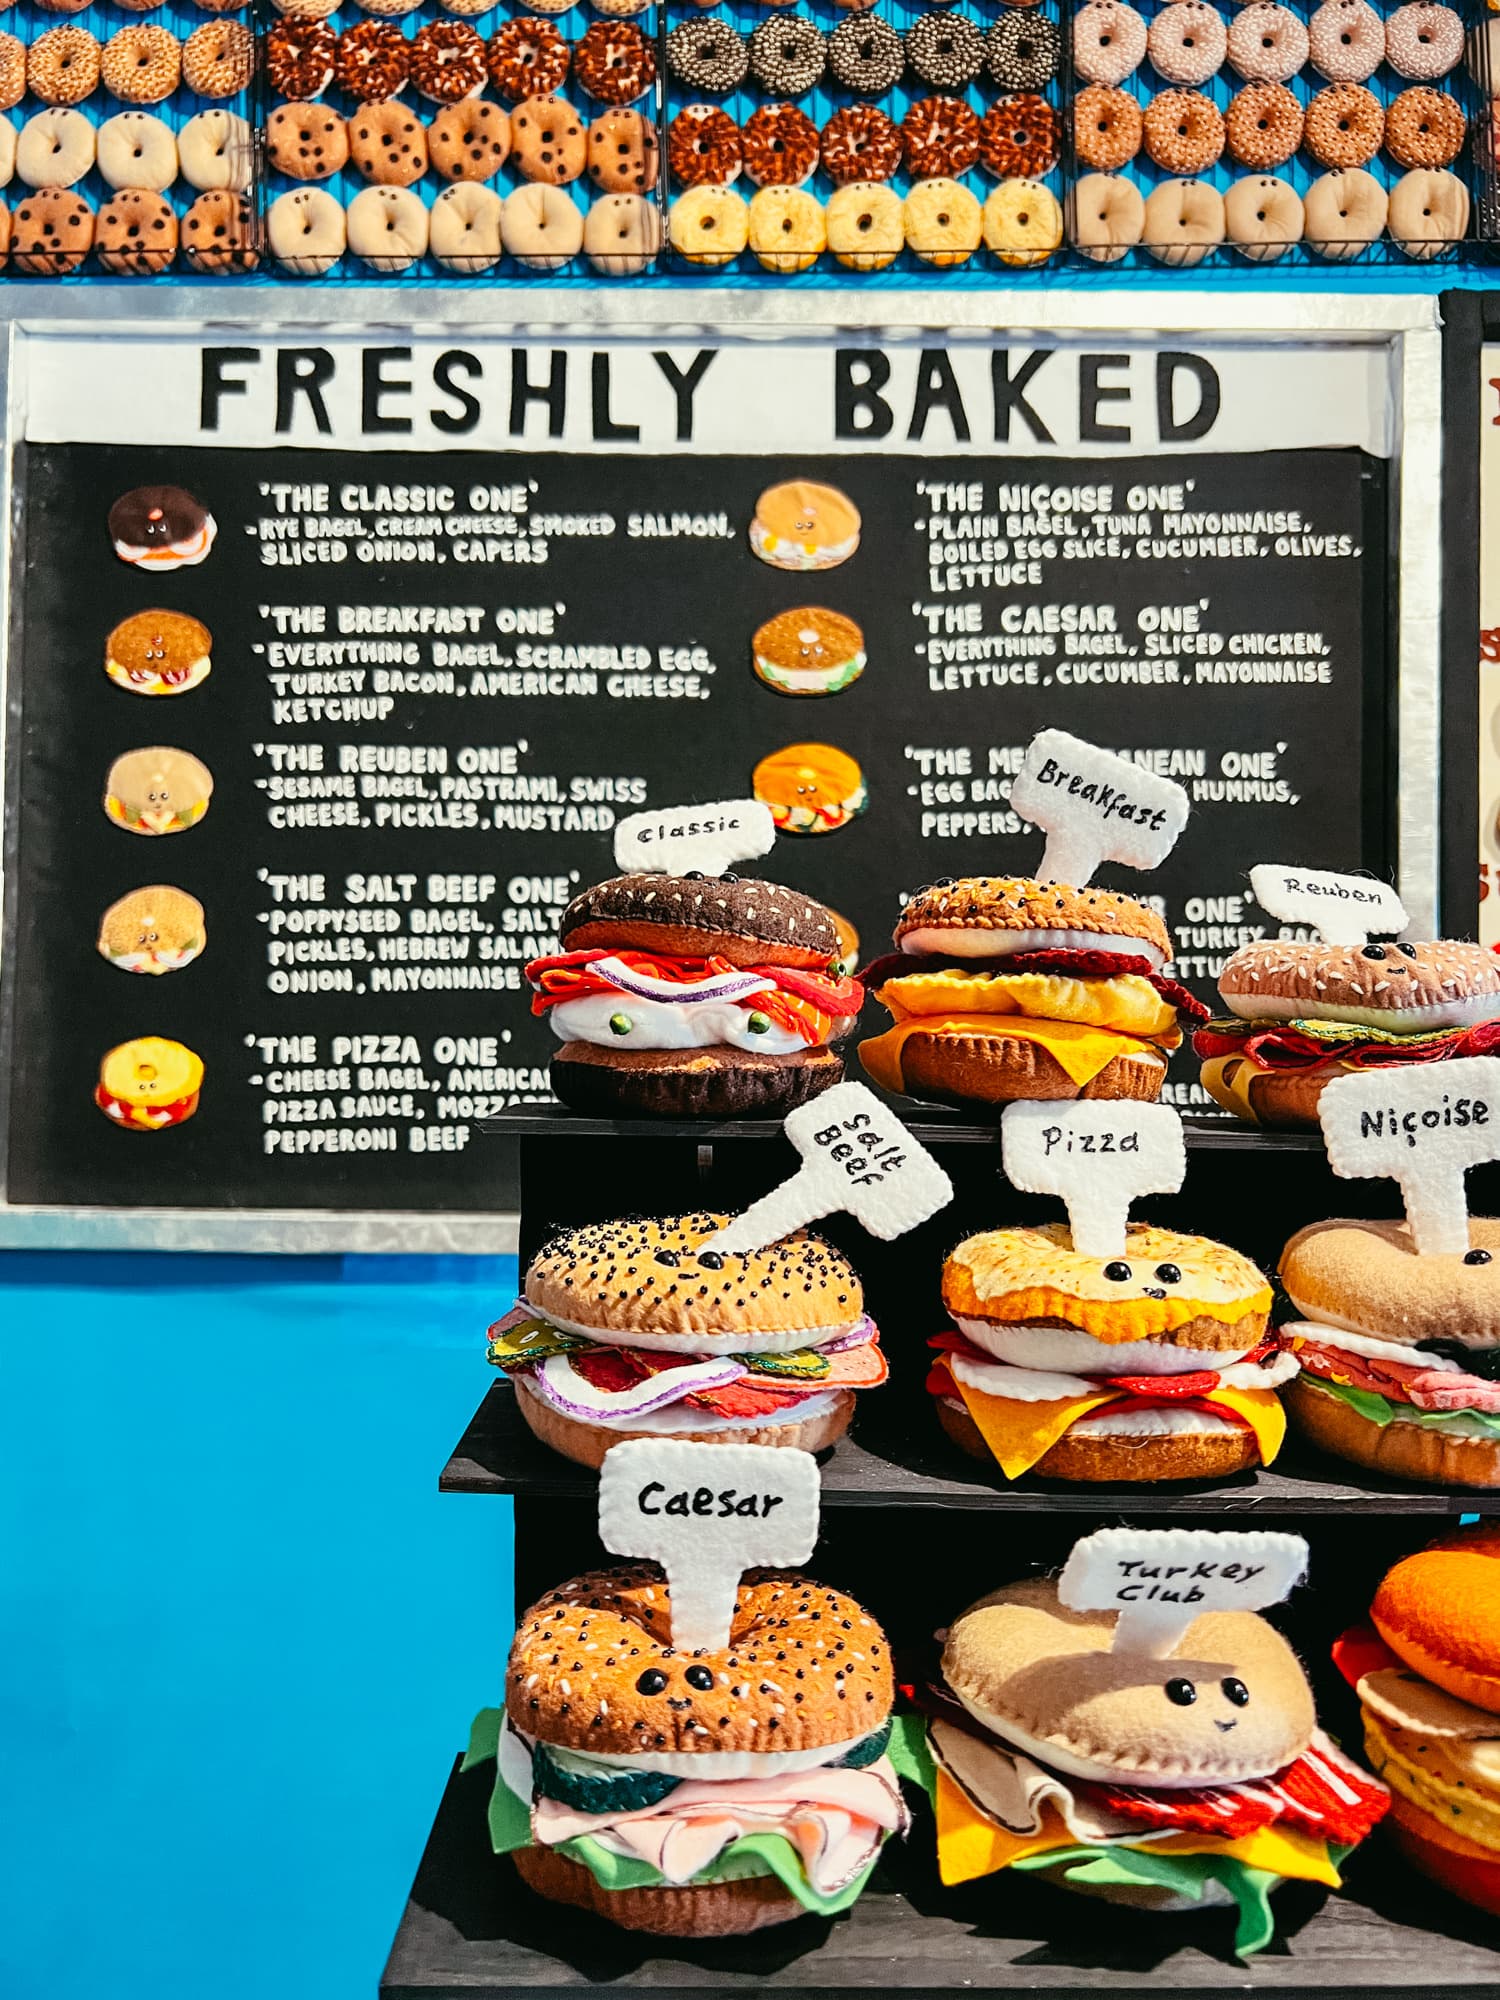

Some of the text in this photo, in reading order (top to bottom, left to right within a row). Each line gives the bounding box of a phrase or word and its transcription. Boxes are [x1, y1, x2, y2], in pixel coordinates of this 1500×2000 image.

[199, 345, 1221, 445] FRESHLY BAKED
[340, 484, 456, 513] CLASSIC
[999, 484, 1114, 518] NIÇOISE
[303, 516, 376, 539] BAGEL,
[374, 516, 445, 537] CREAM
[444, 513, 527, 538] CHEESE,
[528, 513, 617, 537] SMOKED
[626, 511, 737, 539] SALMON,
[1006, 514, 1091, 538] BAGEL,
[1091, 513, 1152, 537] TUNA
[1162, 511, 1313, 537] MAYONNAISE,
[260, 538, 549, 566] SLICED ONION, CAPERS
[928, 534, 1364, 566] BOILED EGG SLICE, CUCUMBER, OLIVES,
[929, 562, 1043, 593] LETTUCE
[337, 606, 486, 635] BREAKFAST
[1001, 604, 1118, 634] CAESAR
[431, 642, 513, 668] BAGEL,
[515, 642, 652, 670] SCRAMBLED
[658, 646, 717, 675] EGG,
[1064, 633, 1139, 657] BAGEL,
[1144, 632, 1225, 657] SLICED
[1228, 631, 1332, 657] CHICKEN,
[267, 669, 711, 700] TURKEY BACON, AMERICAN CHEESE,
[928, 659, 1334, 692] LETTUCE, CUCUMBER, MAYONNAISE
[271, 697, 395, 725] KETCHUP
[338, 745, 448, 774] REUBEN
[361, 776, 438, 801] BAGEL,
[440, 777, 567, 804] PASTRAMI,
[569, 777, 648, 804] SWISS
[971, 778, 1013, 802] BAG
[1037, 758, 1167, 831] Breakfast
[1192, 779, 1301, 806] HUMMUS,
[267, 803, 616, 832] CHEESE, PICKLES, MUSTARD
[637, 816, 740, 843] Classic
[920, 810, 1033, 838] PEPPERS,
[344, 874, 417, 903] SALT
[427, 874, 496, 903] BEEF
[1283, 878, 1382, 905] Reuben
[410, 908, 495, 934] BAGEL,
[502, 907, 564, 933] SALT
[267, 935, 566, 965] PICKLES, HEBREW SALAM
[267, 966, 521, 994] ONION, MAYONNAISE
[331, 1036, 421, 1065] PIZZA
[358, 1068, 441, 1092] BAGEL,
[262, 1097, 336, 1124] PIZZA
[340, 1094, 426, 1120] SAUCE,
[1361, 1095, 1490, 1147] Niçoise
[263, 1125, 470, 1155] PEPPERONI BEEF
[813, 1124, 884, 1185] Beef
[842, 1113, 907, 1172] Salt
[1042, 1125, 1140, 1156] Pizza
[638, 1481, 784, 1519] Caesar
[1117, 1560, 1265, 1584] Turkey
[1116, 1584, 1206, 1604] Club
